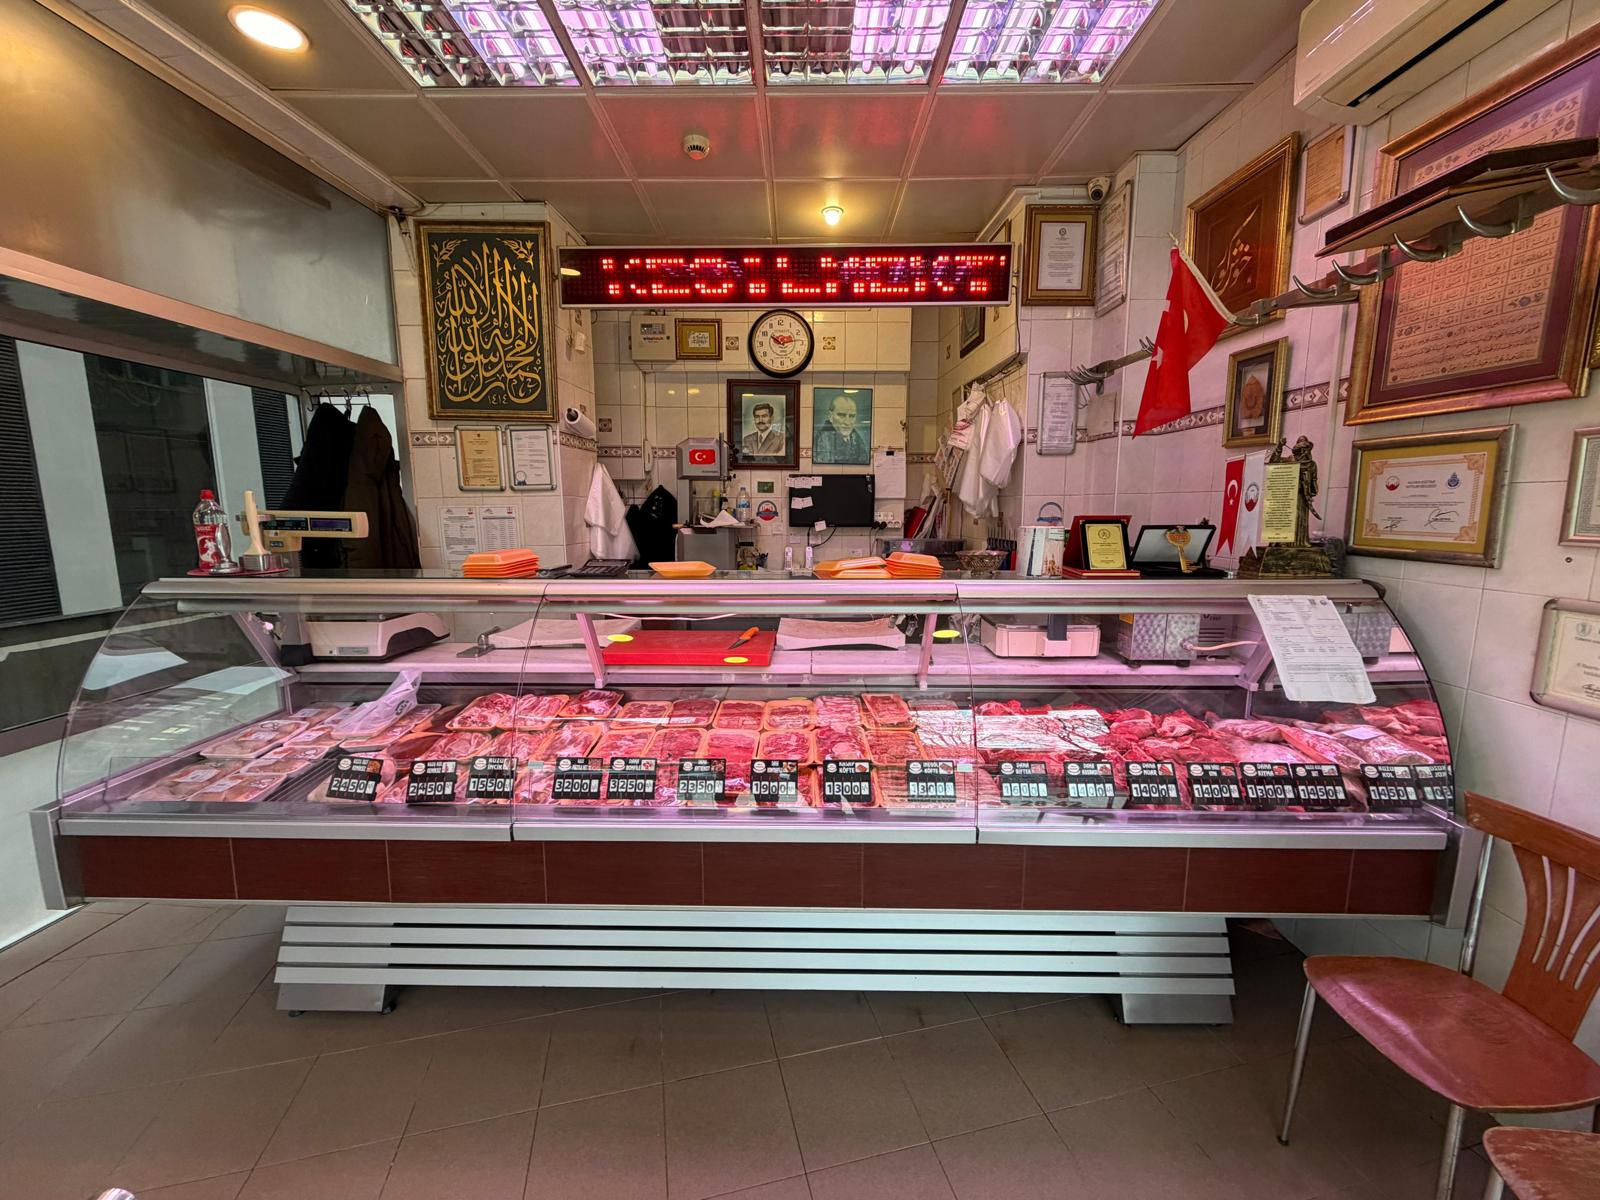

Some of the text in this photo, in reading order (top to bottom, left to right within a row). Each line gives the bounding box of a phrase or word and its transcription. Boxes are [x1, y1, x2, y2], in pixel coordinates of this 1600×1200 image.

[333, 779, 365, 791] 2450
[411, 783, 443, 794] 2450
[471, 779, 504, 790] 1550
[557, 780, 588, 791] 3200
[611, 780, 643, 791] 3250
[680, 781, 713, 793] 2350
[756, 782, 787, 794] 1900
[828, 783, 861, 793] 1300
[912, 783, 943, 794] 1300
[1070, 785, 1105, 796] 1400
[1133, 785, 1168, 797] 1400
[1195, 785, 1229, 797] 1400
[1249, 785, 1283, 798] 1300
[1301, 787, 1335, 798] 1450
[1371, 787, 1406, 799] 1450
